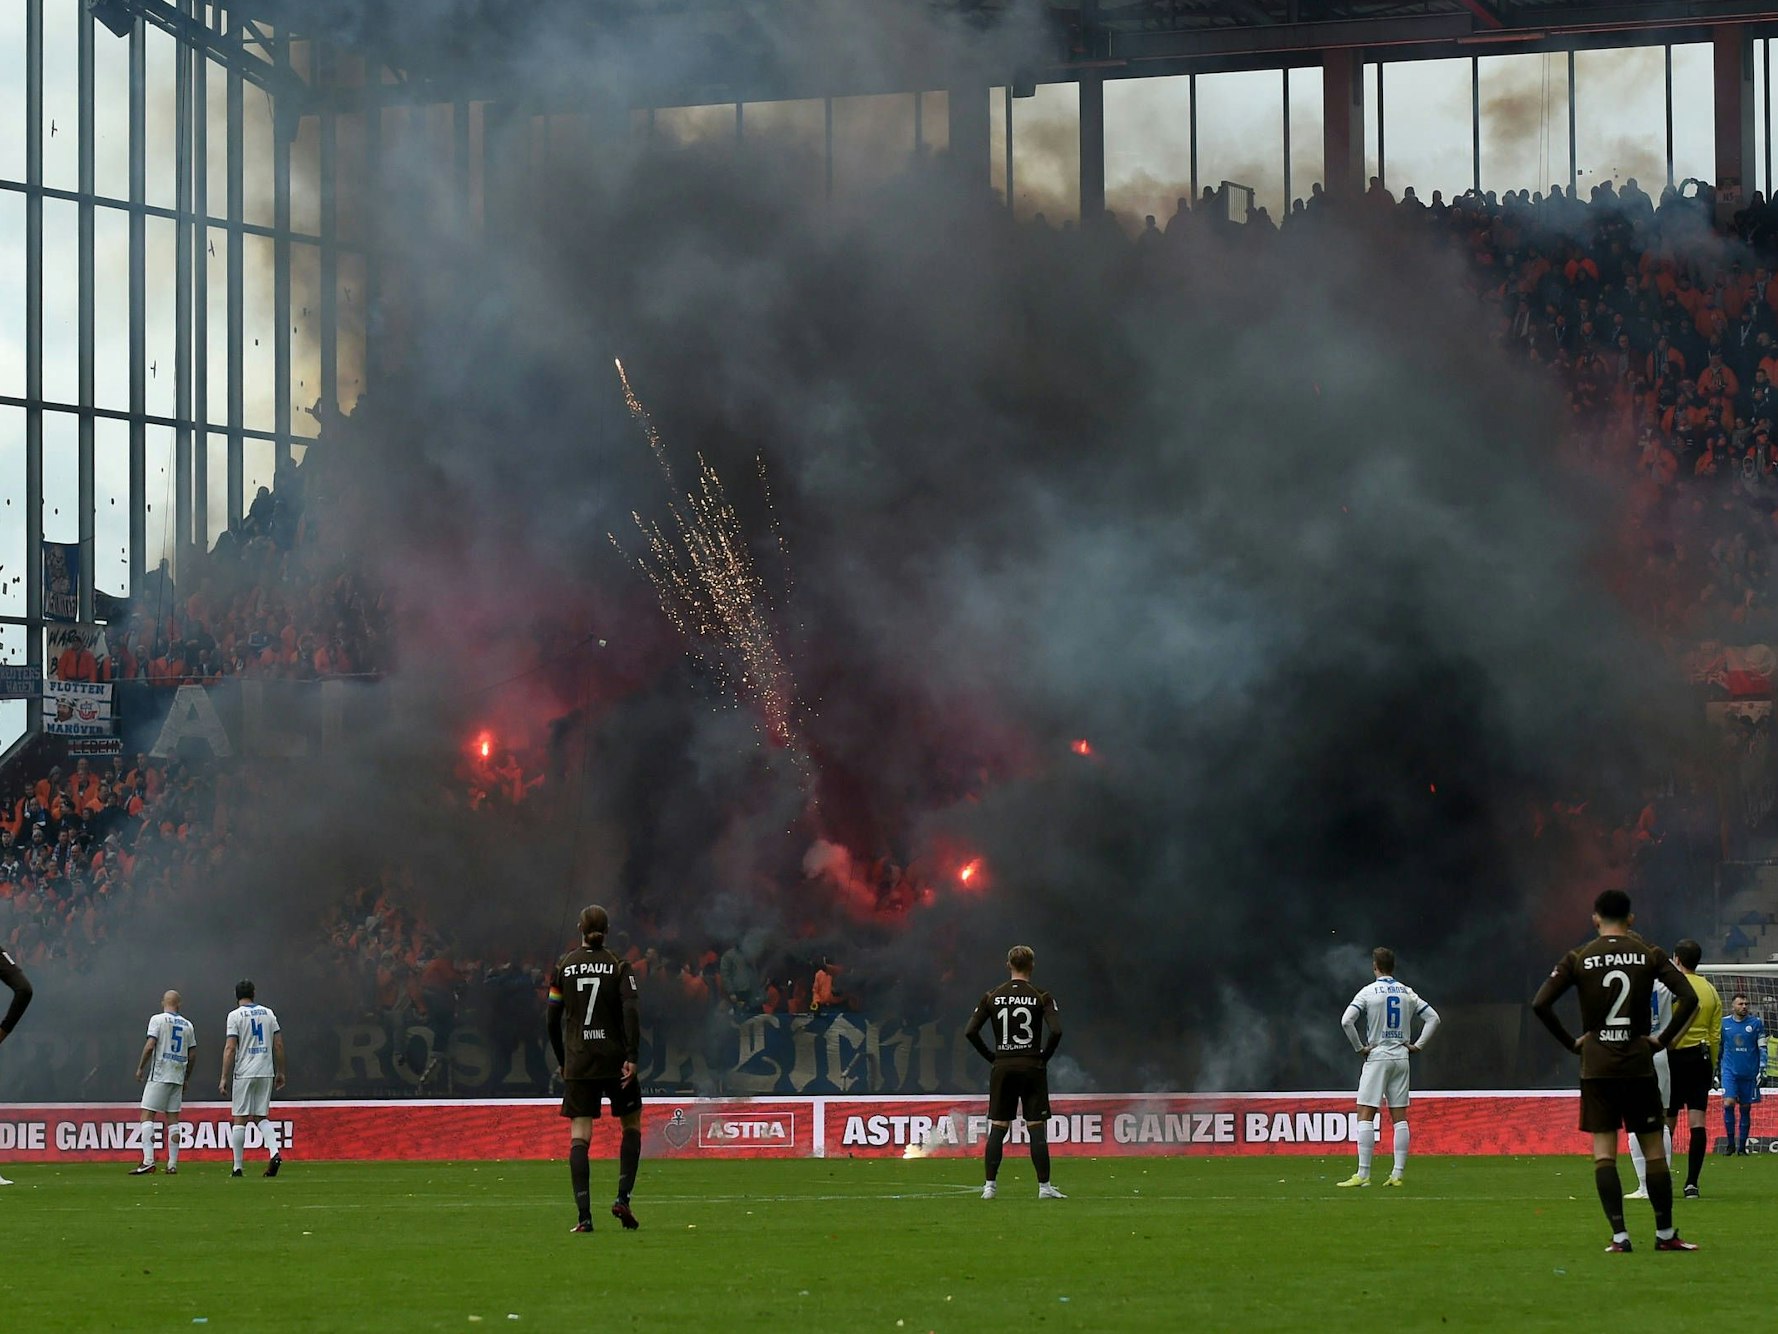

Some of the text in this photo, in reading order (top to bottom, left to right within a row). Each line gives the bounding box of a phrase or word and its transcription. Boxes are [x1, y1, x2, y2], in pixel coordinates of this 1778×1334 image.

[49, 681, 105, 695] FLOTTEN
[47, 723, 103, 735] MANÖVER
[564, 963, 614, 977] ST. PAULI
[1584, 953, 1646, 970] ST. PAULI
[577, 977, 600, 1025] 7
[994, 996, 1037, 1005] ST. PAULI
[1602, 970, 1631, 1026] 2
[997, 1006, 1034, 1045] 13
[1386, 996, 1401, 1029] 6
[171, 1026, 183, 1053] 5
[251, 1018, 263, 1046] 4
[1599, 1029, 1631, 1042] SALIKA
[0, 1122, 46, 1149] DIE
[56, 1121, 164, 1149] GANZE
[706, 1121, 786, 1140] ASTRA
[842, 1115, 960, 1145] ASTRA
[1047, 1114, 1102, 1143] DIE
[1114, 1112, 1235, 1143] GANZE
